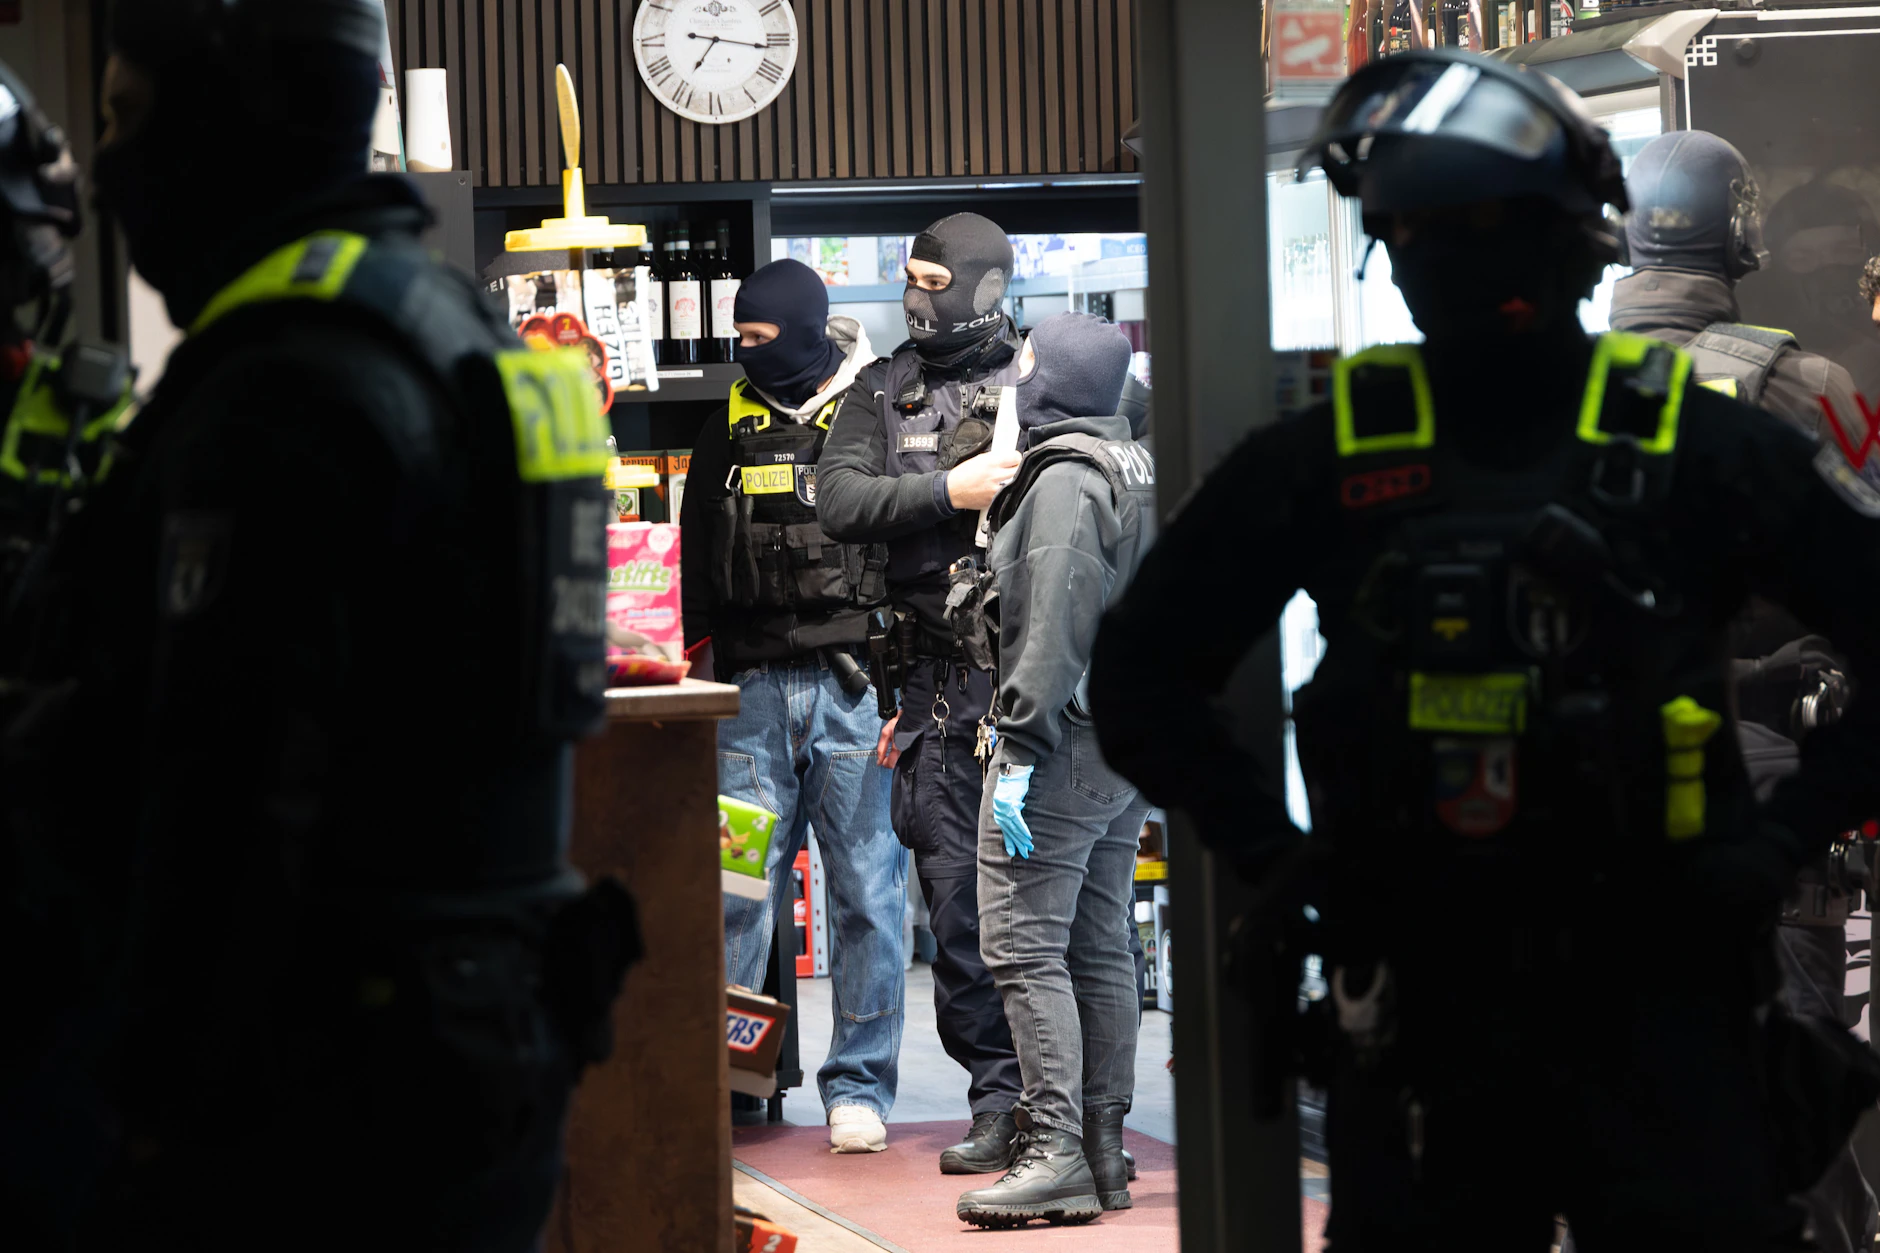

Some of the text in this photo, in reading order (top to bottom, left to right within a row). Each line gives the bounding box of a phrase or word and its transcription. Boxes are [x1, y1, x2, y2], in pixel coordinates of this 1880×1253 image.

[906, 312, 938, 333] OLL
[952, 310, 1001, 334] ZOLL
[903, 436, 934, 448] 13693
[774, 452, 795, 462] 72570
[745, 470, 790, 489] POLIZEI
